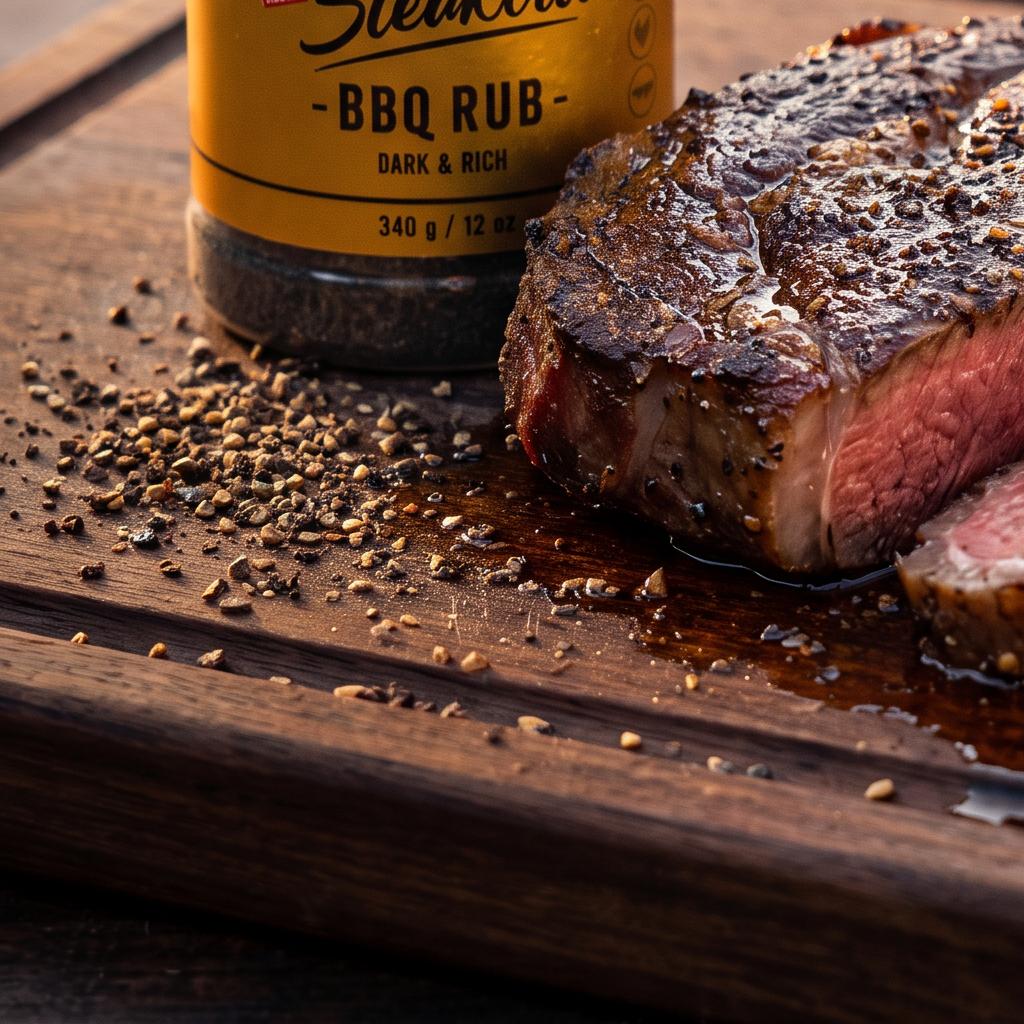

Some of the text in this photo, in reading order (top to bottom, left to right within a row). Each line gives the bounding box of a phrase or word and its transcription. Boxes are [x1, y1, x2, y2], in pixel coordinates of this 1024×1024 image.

[339, 78, 543, 142] BBQ RUB
[378, 149, 508, 175] DARK & RICH
[379, 215, 416, 237] 340
[426, 221, 437, 241] g
[464, 214, 485, 236] 12
[494, 215, 516, 232] oz
